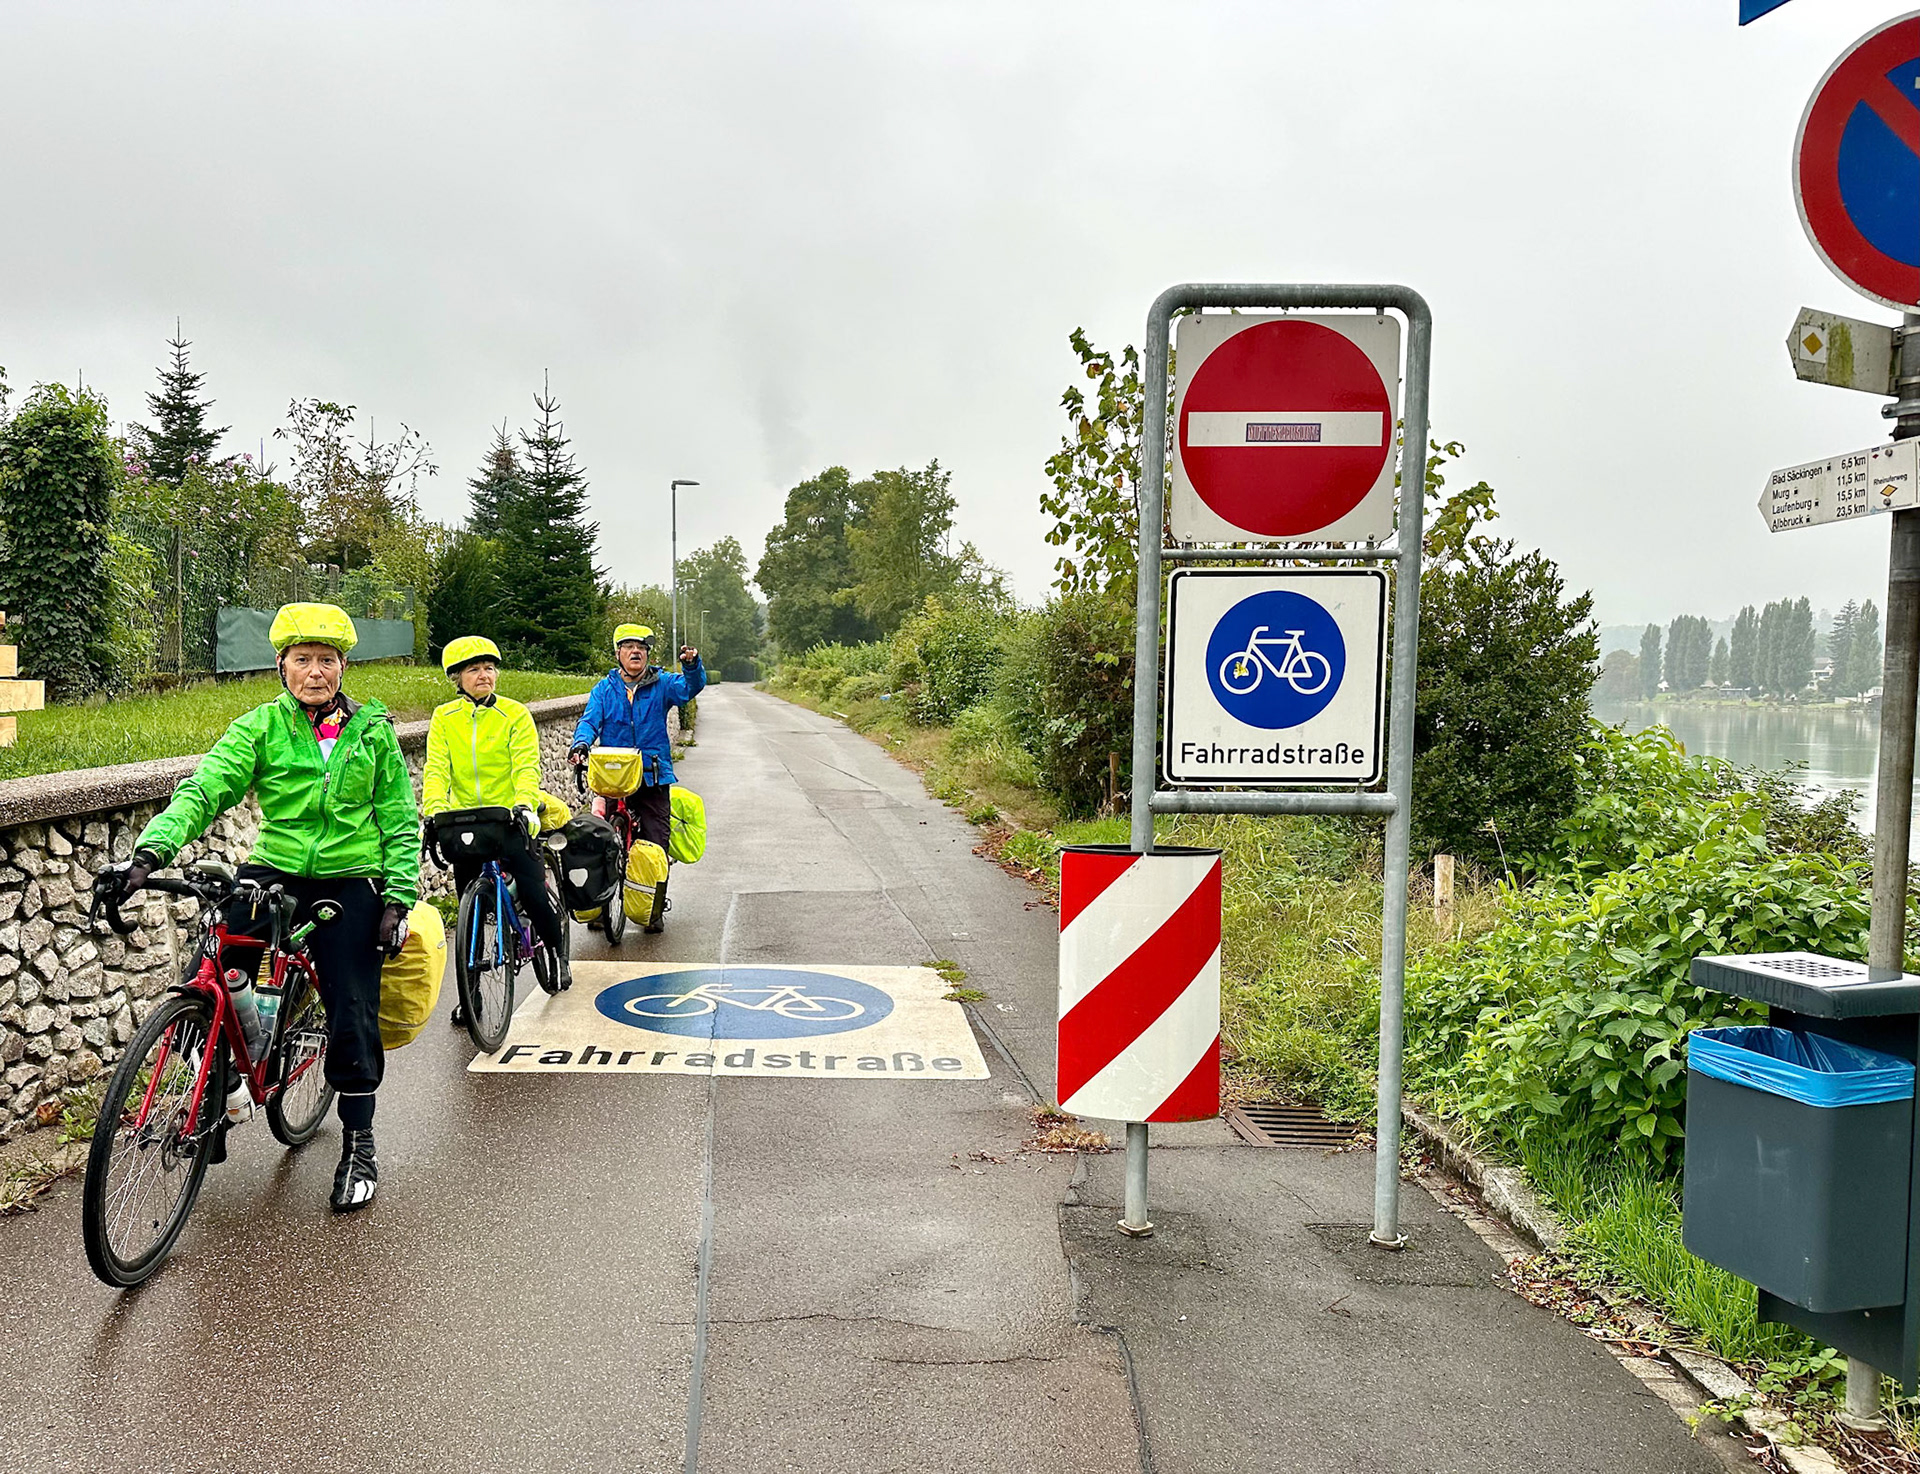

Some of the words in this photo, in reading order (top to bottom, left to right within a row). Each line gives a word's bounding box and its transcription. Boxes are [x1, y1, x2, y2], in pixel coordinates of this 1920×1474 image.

[1772, 473, 1786, 485] Bad
[1786, 466, 1823, 481] Säckingen
[1841, 458, 1853, 470] 6,5
[1854, 456, 1866, 468] km
[1772, 488, 1790, 500] Murg
[1837, 475, 1852, 486] 11,5
[1854, 472, 1866, 483] km
[1772, 499, 1812, 515] Laufenburg
[1837, 490, 1852, 502] 15,5
[1854, 488, 1866, 499] km
[1772, 515, 1804, 530] Albbruck
[1836, 506, 1853, 518] 23,5
[1853, 503, 1866, 515] km
[1181, 742, 1365, 764] Fahrradstraße
[498, 1044, 964, 1072] Fahrradstraße
